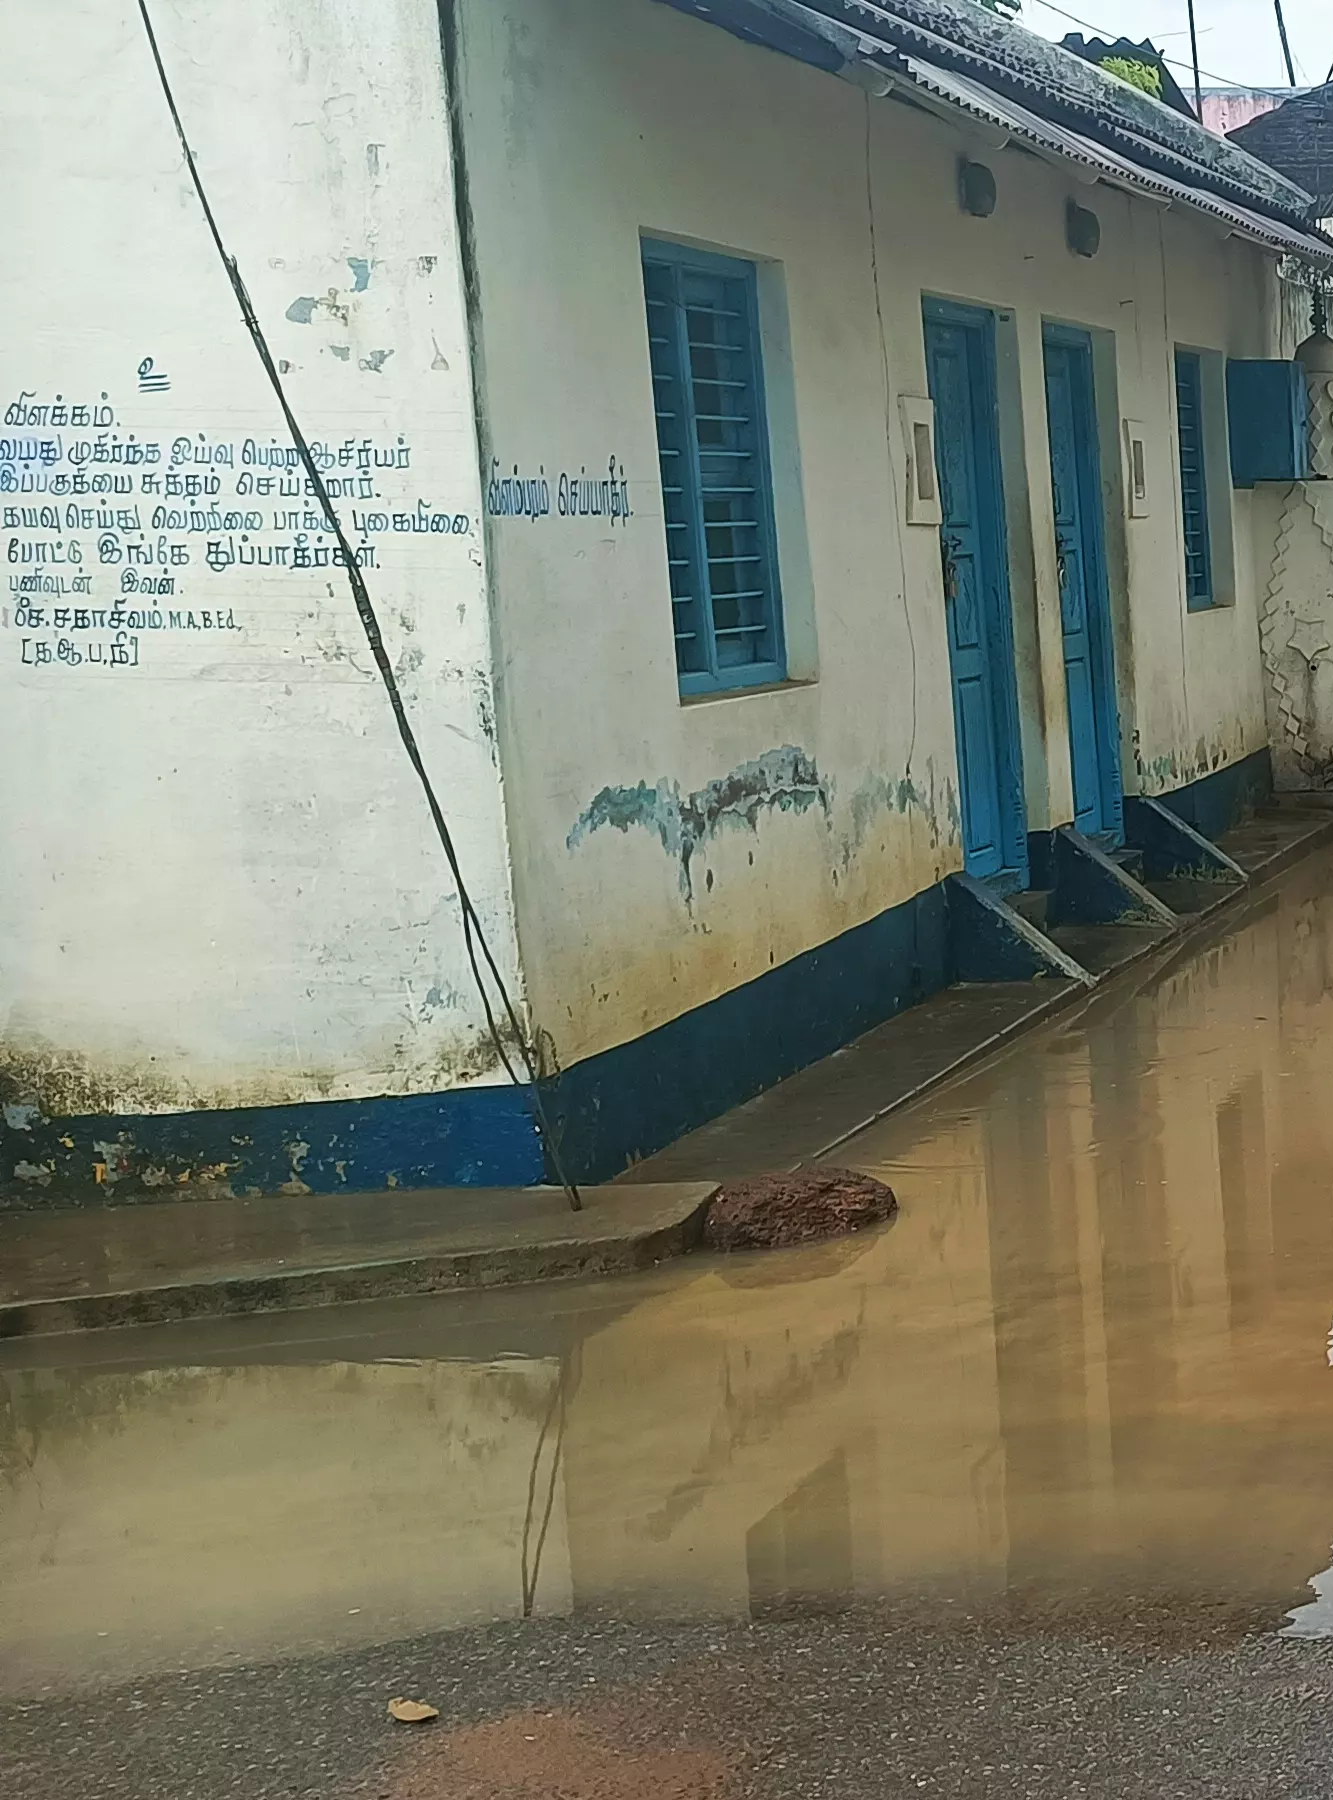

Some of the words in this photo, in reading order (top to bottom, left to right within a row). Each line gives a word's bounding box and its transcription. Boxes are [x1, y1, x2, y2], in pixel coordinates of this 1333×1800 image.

[4, 390, 121, 427] விளக்கம்.
[0, 434, 62, 466] வயது
[242, 438, 303, 470] பெற்ற
[308, 436, 411, 470] ஆசிரியர்
[0, 463, 133, 496] இப்பகுதியை
[141, 465, 221, 501] சுத்தம்
[488, 455, 550, 523] விளம்பரம்
[2, 504, 61, 533] தயவு
[66, 499, 141, 534] செய்து
[152, 499, 264, 534] வெற்றிலை
[7, 538, 82, 564] போட்டு
[98, 532, 190, 565] இங்கே
[9, 567, 92, 598] பணிவுடன்
